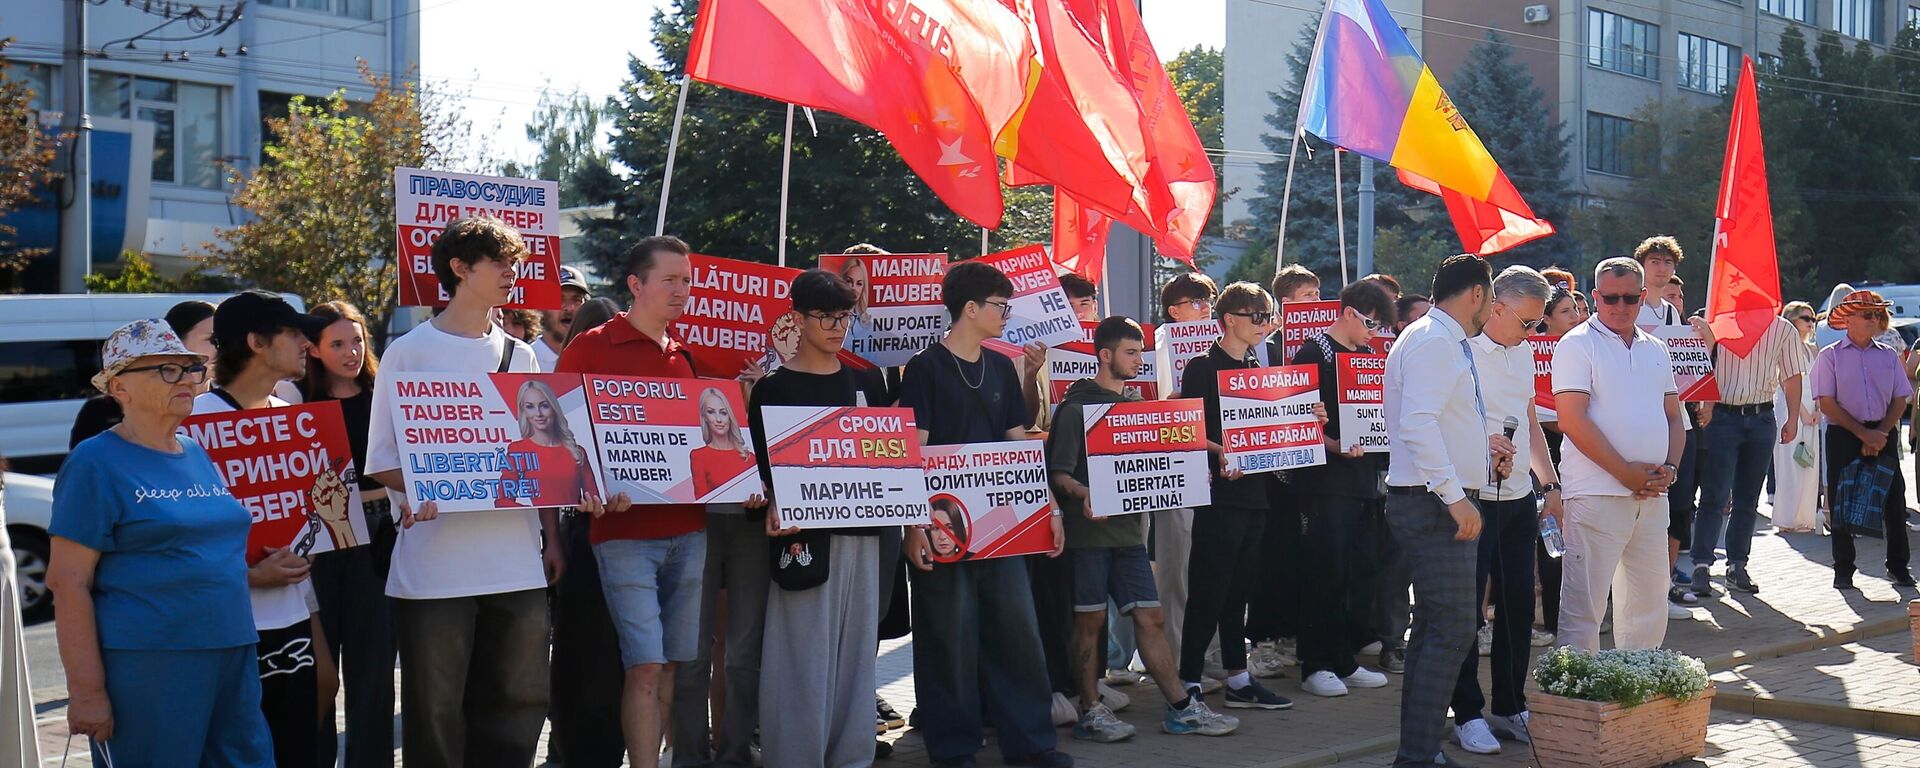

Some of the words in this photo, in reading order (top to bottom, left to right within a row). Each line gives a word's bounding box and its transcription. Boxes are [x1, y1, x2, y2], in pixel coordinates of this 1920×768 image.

[410, 175, 545, 207] ПРАВОСУДИЕ
[415, 203, 459, 223] ДЛЯ
[872, 258, 943, 277] MARINA
[688, 264, 768, 297] LĂTURI
[774, 279, 792, 299] D
[1008, 268, 1052, 293] АУБЕР
[873, 284, 942, 303] TAUBER
[1039, 291, 1066, 313] НЕ
[873, 317, 893, 332] NU
[897, 315, 941, 331] POATE
[1286, 307, 1338, 325] ADEVĂRUL
[675, 322, 766, 353] TAUBER!
[1007, 314, 1075, 344] СЛОМИТЬ!
[1171, 324, 1219, 338] МАРИНА
[1286, 328, 1300, 342] DE
[852, 339, 864, 353] FI
[1350, 357, 1386, 369] PERSEC
[1229, 373, 1247, 391] SĂ
[1249, 375, 1259, 390] O
[1261, 370, 1310, 389] APĂRĂM
[1357, 370, 1385, 385] ÎMPOT
[396, 381, 483, 398] MARINA
[593, 379, 687, 400] POPORUL
[1346, 389, 1382, 401] MARINEI
[400, 405, 484, 421] TAUBER
[597, 403, 646, 421] ESTE
[1105, 411, 1171, 428] TERMENELE
[1173, 409, 1203, 422] SUNT
[1222, 409, 1236, 421] PE
[1238, 406, 1279, 420] MARINA
[1357, 408, 1378, 419] SUNT
[296, 411, 316, 439] С
[838, 416, 902, 433] СРОКИ
[1370, 422, 1387, 432] ASU
[404, 427, 512, 445] SIMBOLUL
[604, 429, 665, 446] ALĂTURI
[668, 433, 688, 446] DE
[1113, 430, 1158, 445] PENTRU
[1160, 425, 1196, 445] PAS!
[1230, 430, 1248, 448] SĂ
[1250, 431, 1267, 446] NE
[1269, 425, 1317, 445] APĂRĂM
[607, 450, 666, 463] MARINA
[808, 438, 856, 462] ДЛЯ
[860, 439, 908, 459] PAS!
[973, 449, 1043, 468] ПРЕКРАТИ
[1114, 457, 1170, 475] MARINEI
[1237, 449, 1315, 471] LIBERTATEA!
[610, 468, 672, 481] TAUBER!
[1117, 474, 1185, 494] LIBERTATE
[187, 483, 211, 497] all
[415, 478, 541, 501] NOASTRE!
[801, 481, 884, 501] МАРИНЕ
[986, 488, 1048, 508] ТЕРРОР!
[1122, 490, 1182, 512] DEPLINĂ!
[782, 502, 850, 521] ПОЛНУЮ
[854, 503, 928, 521] СВОБОДУ!
